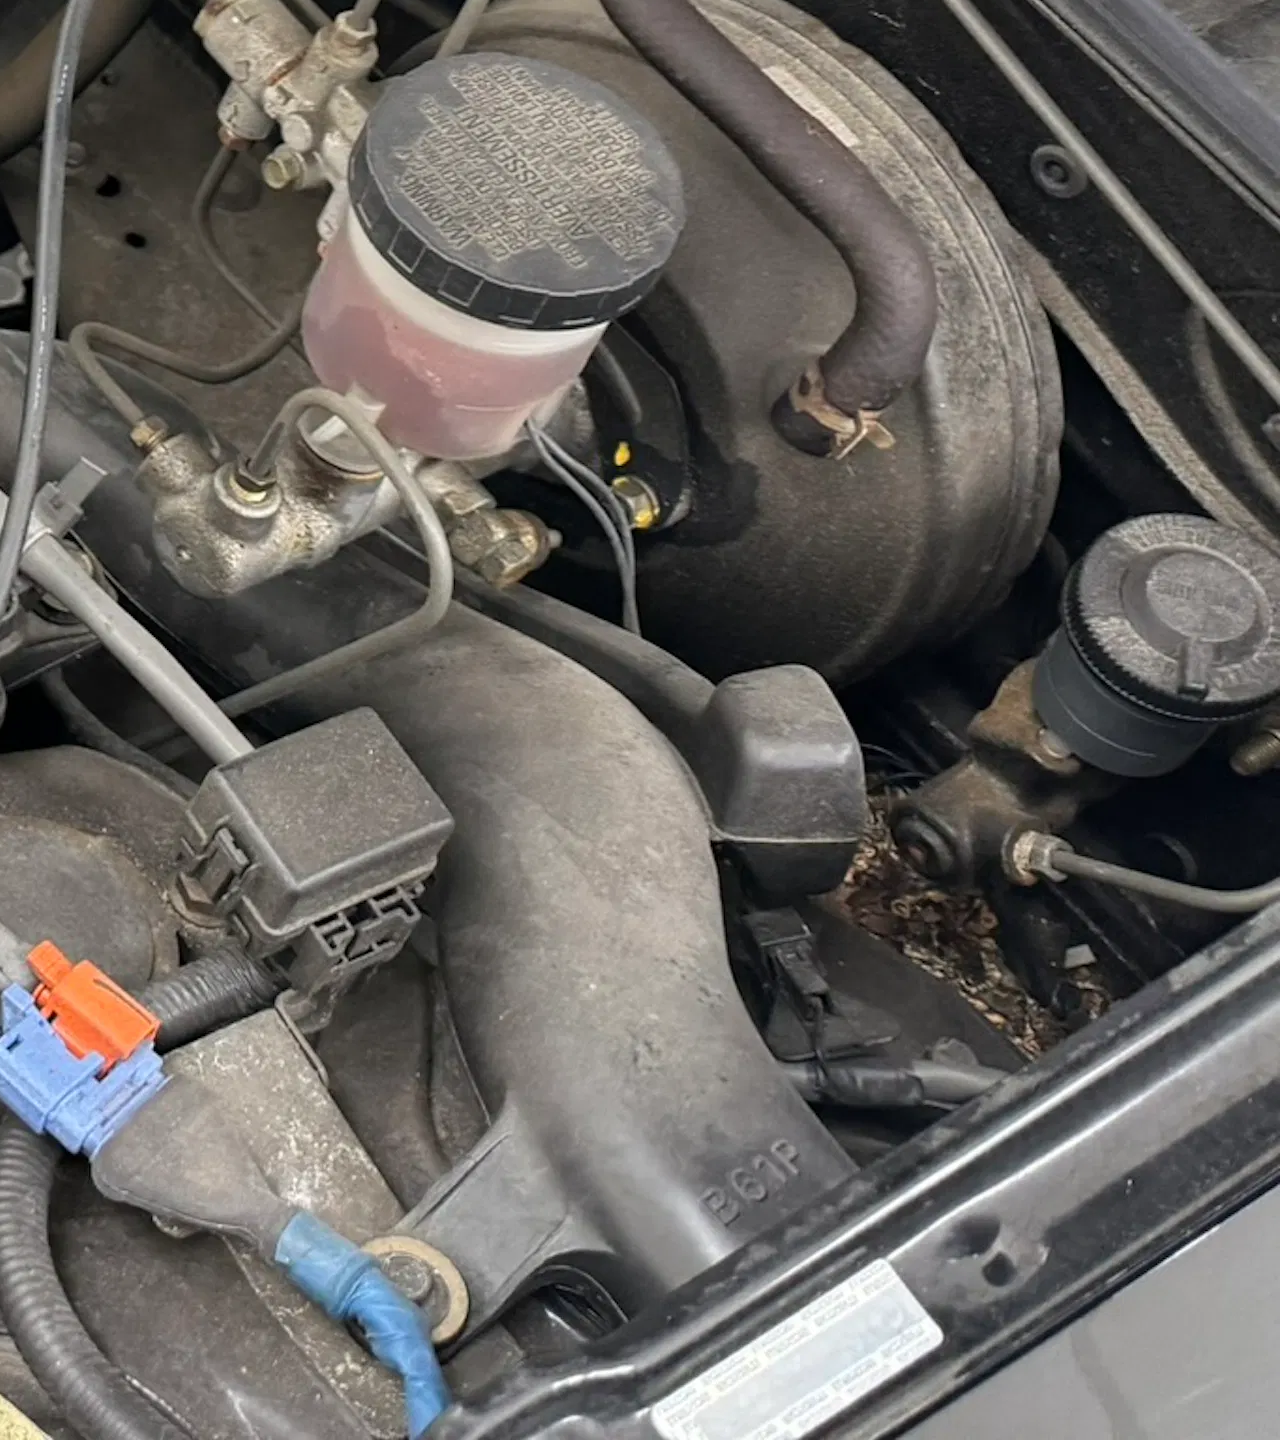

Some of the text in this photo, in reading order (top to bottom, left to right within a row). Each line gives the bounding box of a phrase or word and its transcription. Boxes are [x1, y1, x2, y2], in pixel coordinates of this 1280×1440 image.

[487, 66, 536, 112] LIQUIDE
[417, 99, 488, 168] CONTAINER
[424, 127, 462, 163] FLUID
[422, 173, 466, 215] FILLER
[451, 103, 591, 239] AVERTISSEMENT
[463, 170, 492, 193] DOT
[397, 173, 471, 250] WARNING
[413, 139, 524, 252] BEFORE REMOVING
[461, 216, 509, 259] CLEAN
[514, 223, 543, 248] USE
[694, 1133, 809, 1229] B61P
